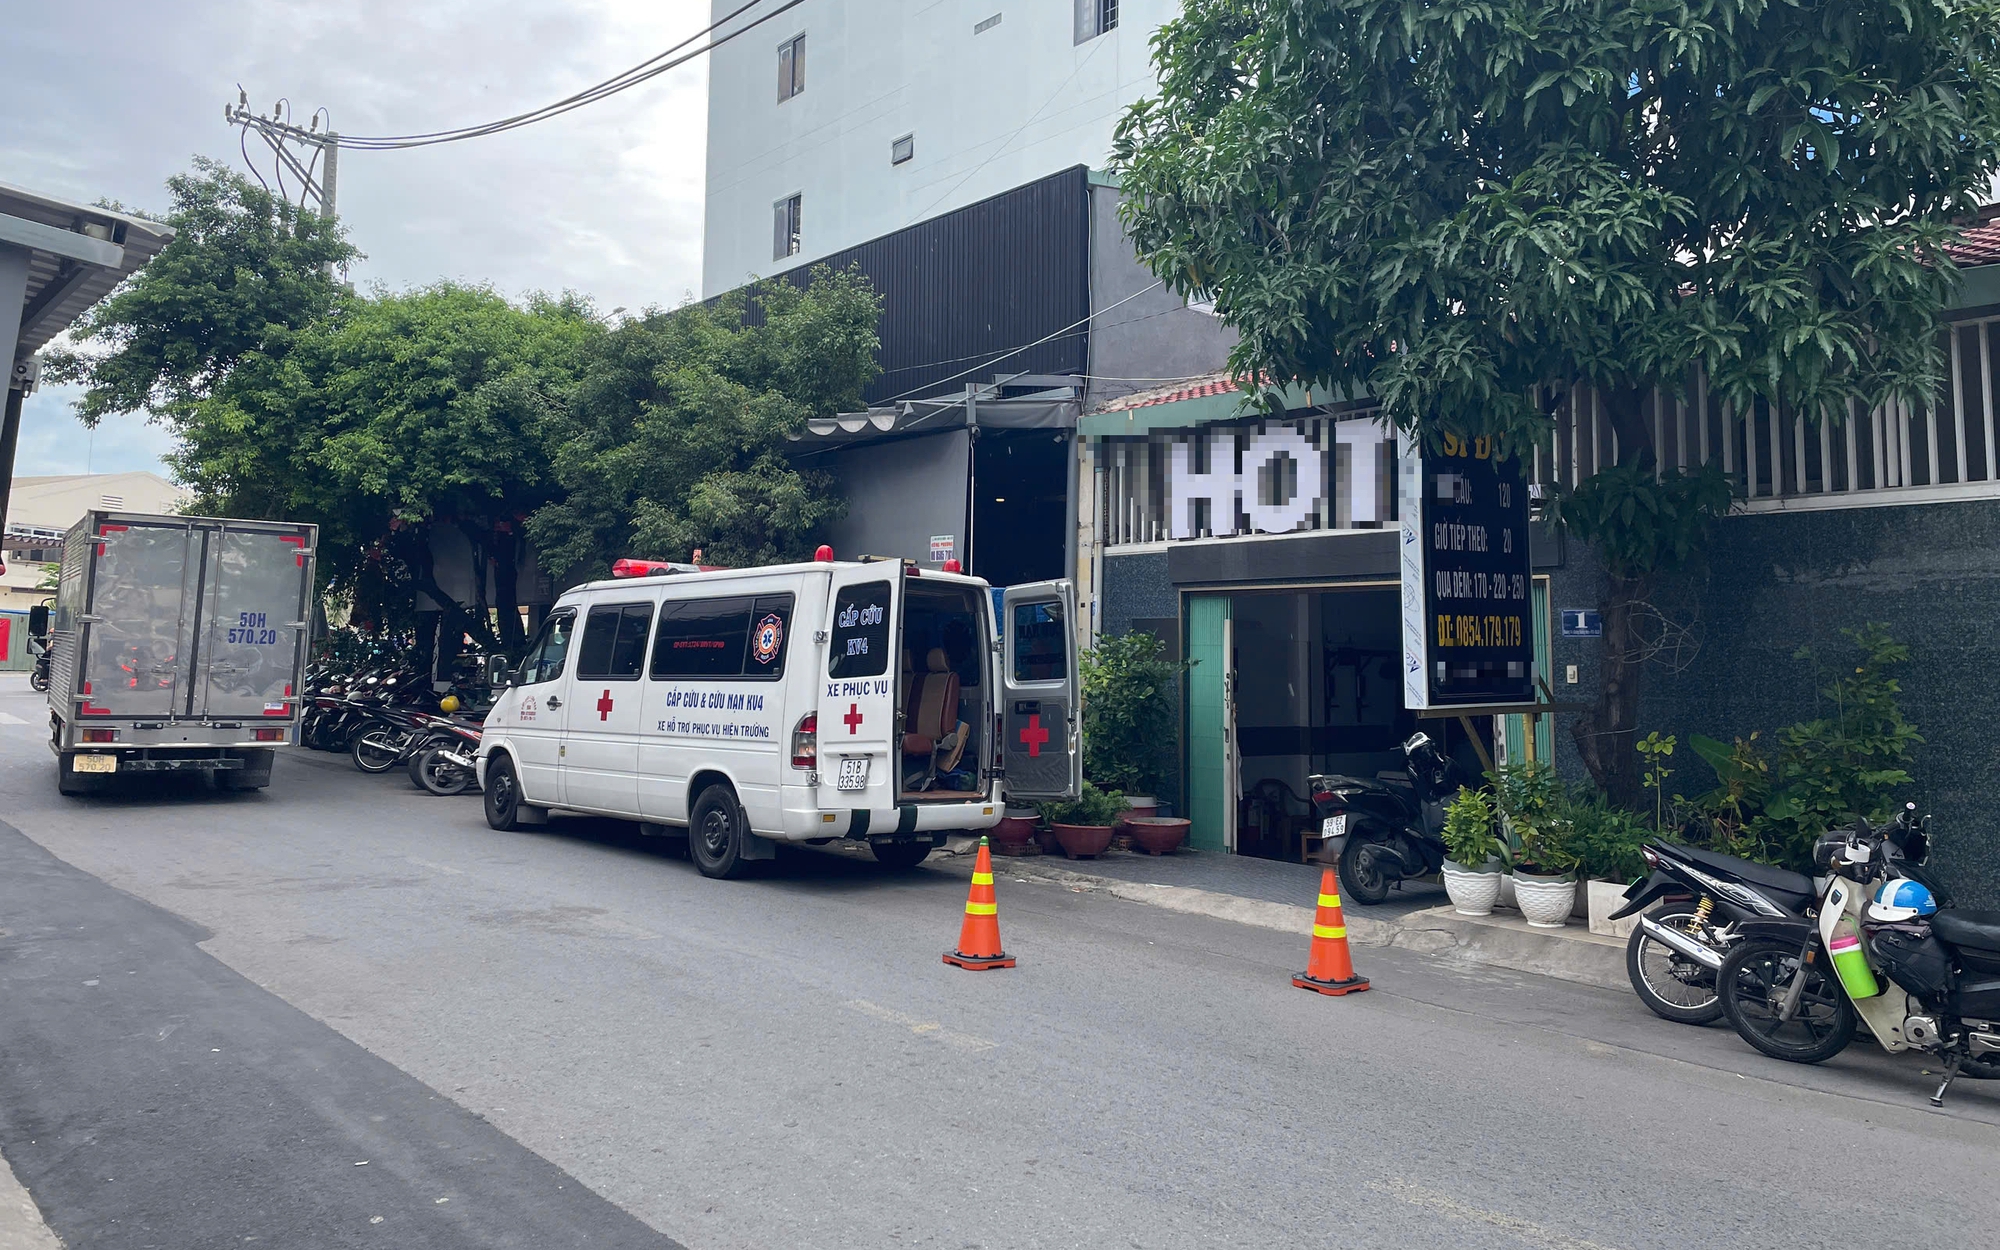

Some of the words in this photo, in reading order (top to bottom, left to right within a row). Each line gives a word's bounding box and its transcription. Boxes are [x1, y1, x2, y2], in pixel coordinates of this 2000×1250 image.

[1498, 483, 1511, 508] 120
[1467, 525, 1488, 552] THEO:
[1503, 528, 1512, 553] 20
[1436, 570, 1452, 600] QUA
[1474, 573, 1488, 599] 170
[1493, 573, 1507, 599] 220
[1512, 574, 1525, 600] 250
[240, 612, 266, 628] 50H
[838, 603, 859, 628] CẤP
[860, 603, 883, 626] CỨU
[1575, 612, 1588, 629] 1
[228, 629, 276, 645] 570.20
[846, 637, 868, 656] KV4
[827, 683, 839, 697] XE
[842, 682, 870, 699] PHỤC
[874, 680, 888, 698] VỤ
[666, 686, 682, 708] CẤP
[683, 689, 699, 708] CỨU
[700, 692, 706, 709] &
[708, 690, 725, 709] CỨU
[727, 693, 745, 713] NẠN
[657, 720, 666, 731] XE
[692, 722, 710, 736] PHỤC
[711, 723, 721, 737] VỤ
[722, 722, 739, 738] HIỆN
[87, 755, 104, 763] 50H
[847, 760, 862, 774] 51B
